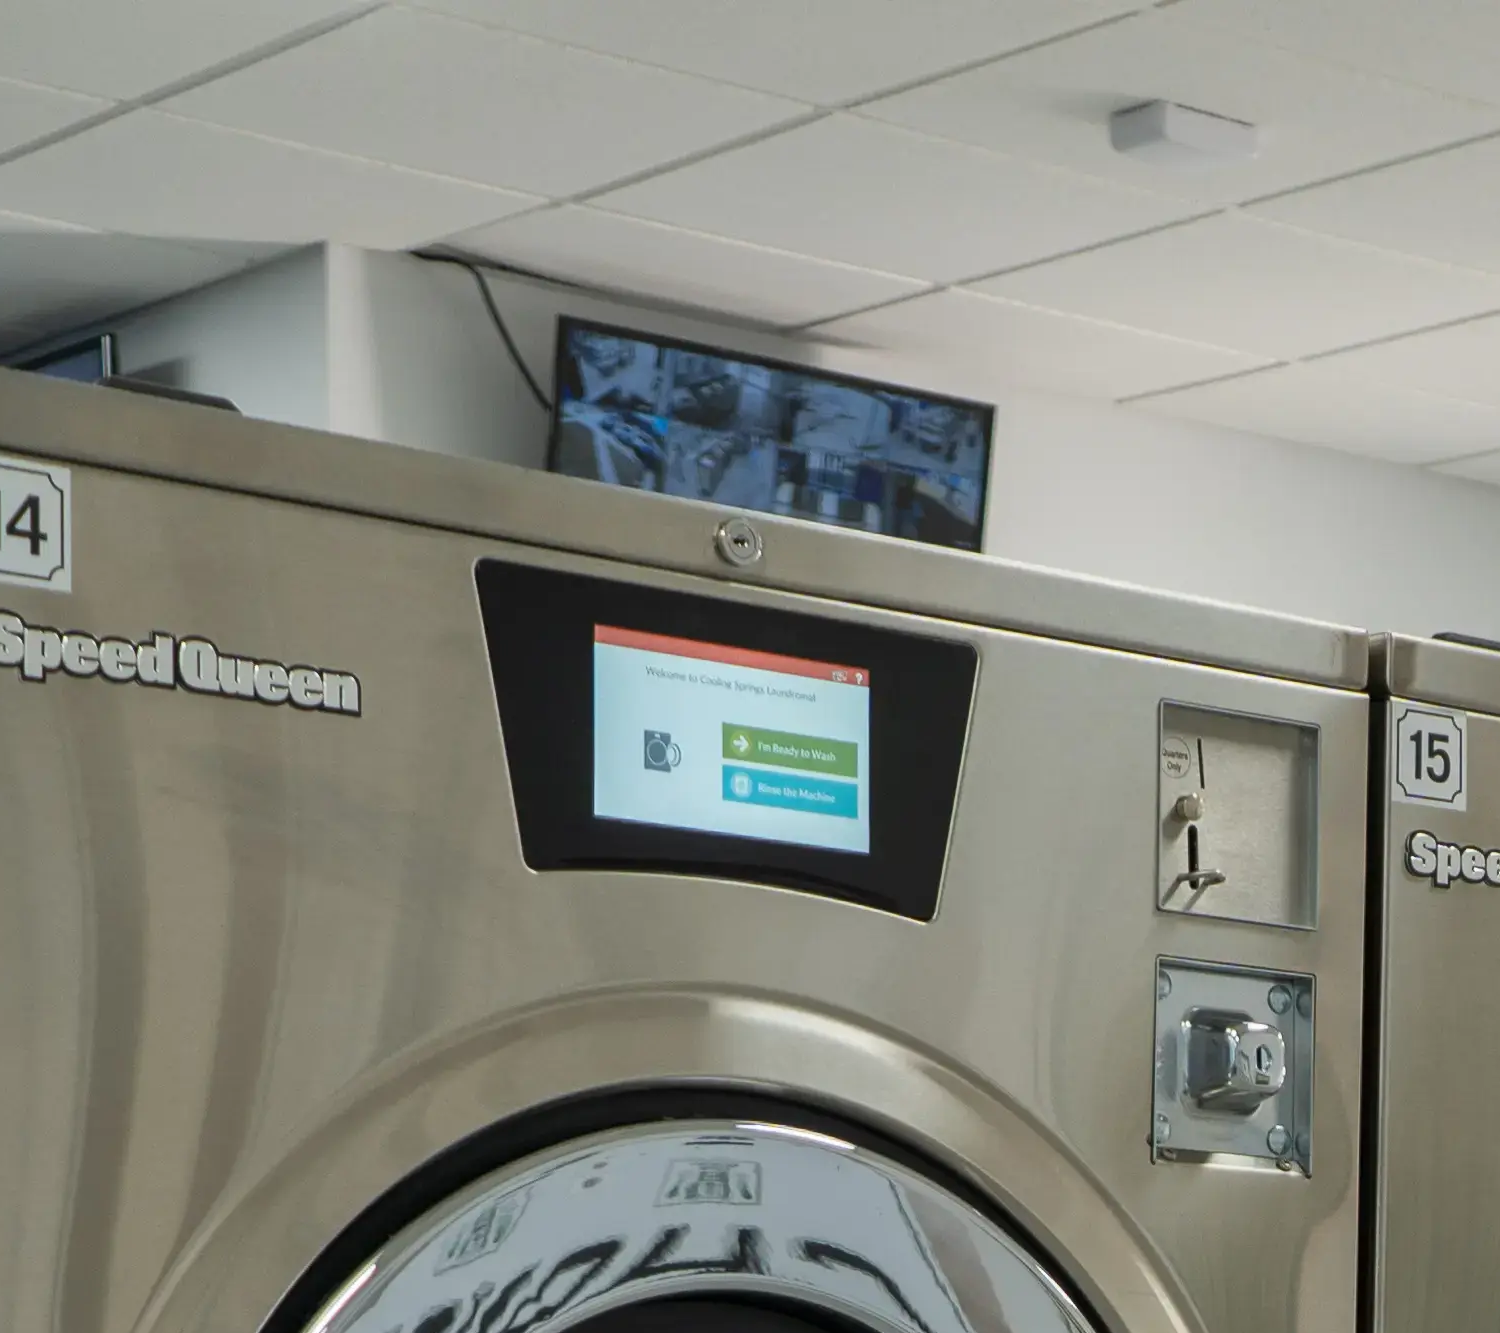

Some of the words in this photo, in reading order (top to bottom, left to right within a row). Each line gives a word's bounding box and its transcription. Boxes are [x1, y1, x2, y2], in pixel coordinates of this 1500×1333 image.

[177, 634, 362, 716] Queen
[646, 666, 687, 683] Welcome
[689, 673, 698, 683] to
[700, 674, 732, 690] Cooling
[735, 680, 764, 696] Springs
[767, 686, 816, 702] Laundromat
[772, 743, 799, 758] Ready
[801, 748, 810, 758] to
[812, 749, 836, 762] Wash
[1410, 729, 1451, 784] 15
[783, 786, 797, 798] the
[799, 789, 835, 803] Machine
